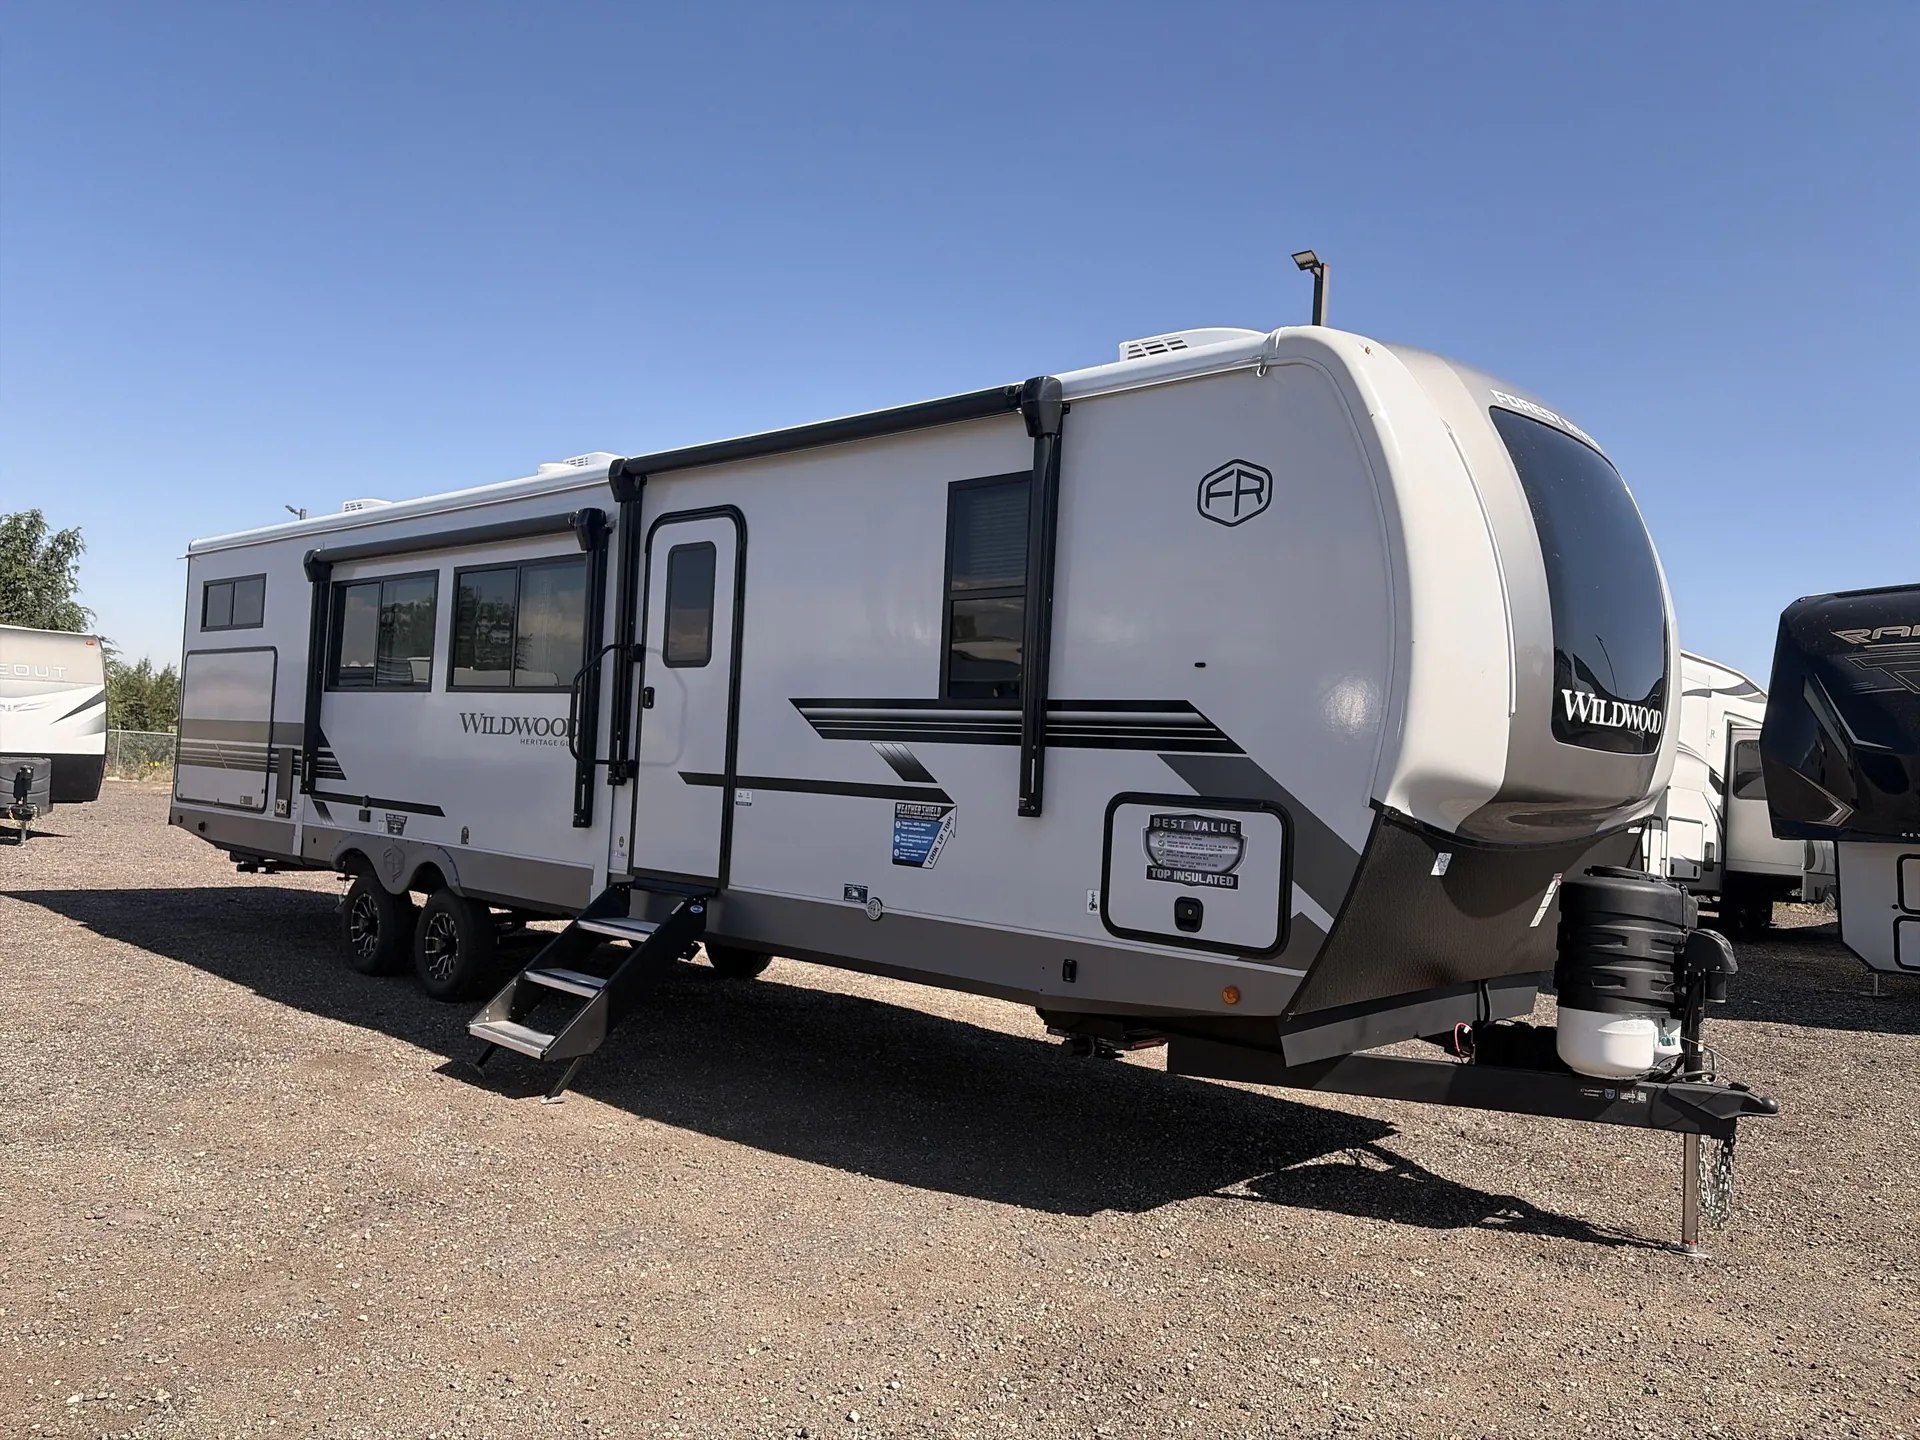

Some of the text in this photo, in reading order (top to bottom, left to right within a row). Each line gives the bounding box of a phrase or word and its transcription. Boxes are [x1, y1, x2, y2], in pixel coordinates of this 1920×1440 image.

[1490, 389, 1564, 426] FOREST
[1561, 689, 1662, 734] WILDWOOD
[520, 738, 558, 746] HERITAGE
[1153, 818, 1237, 834] BEST VALUE
[928, 846, 939, 865] LOOK
[937, 834, 944, 846] UP
[1150, 868, 1234, 886] TOP INSULATED
